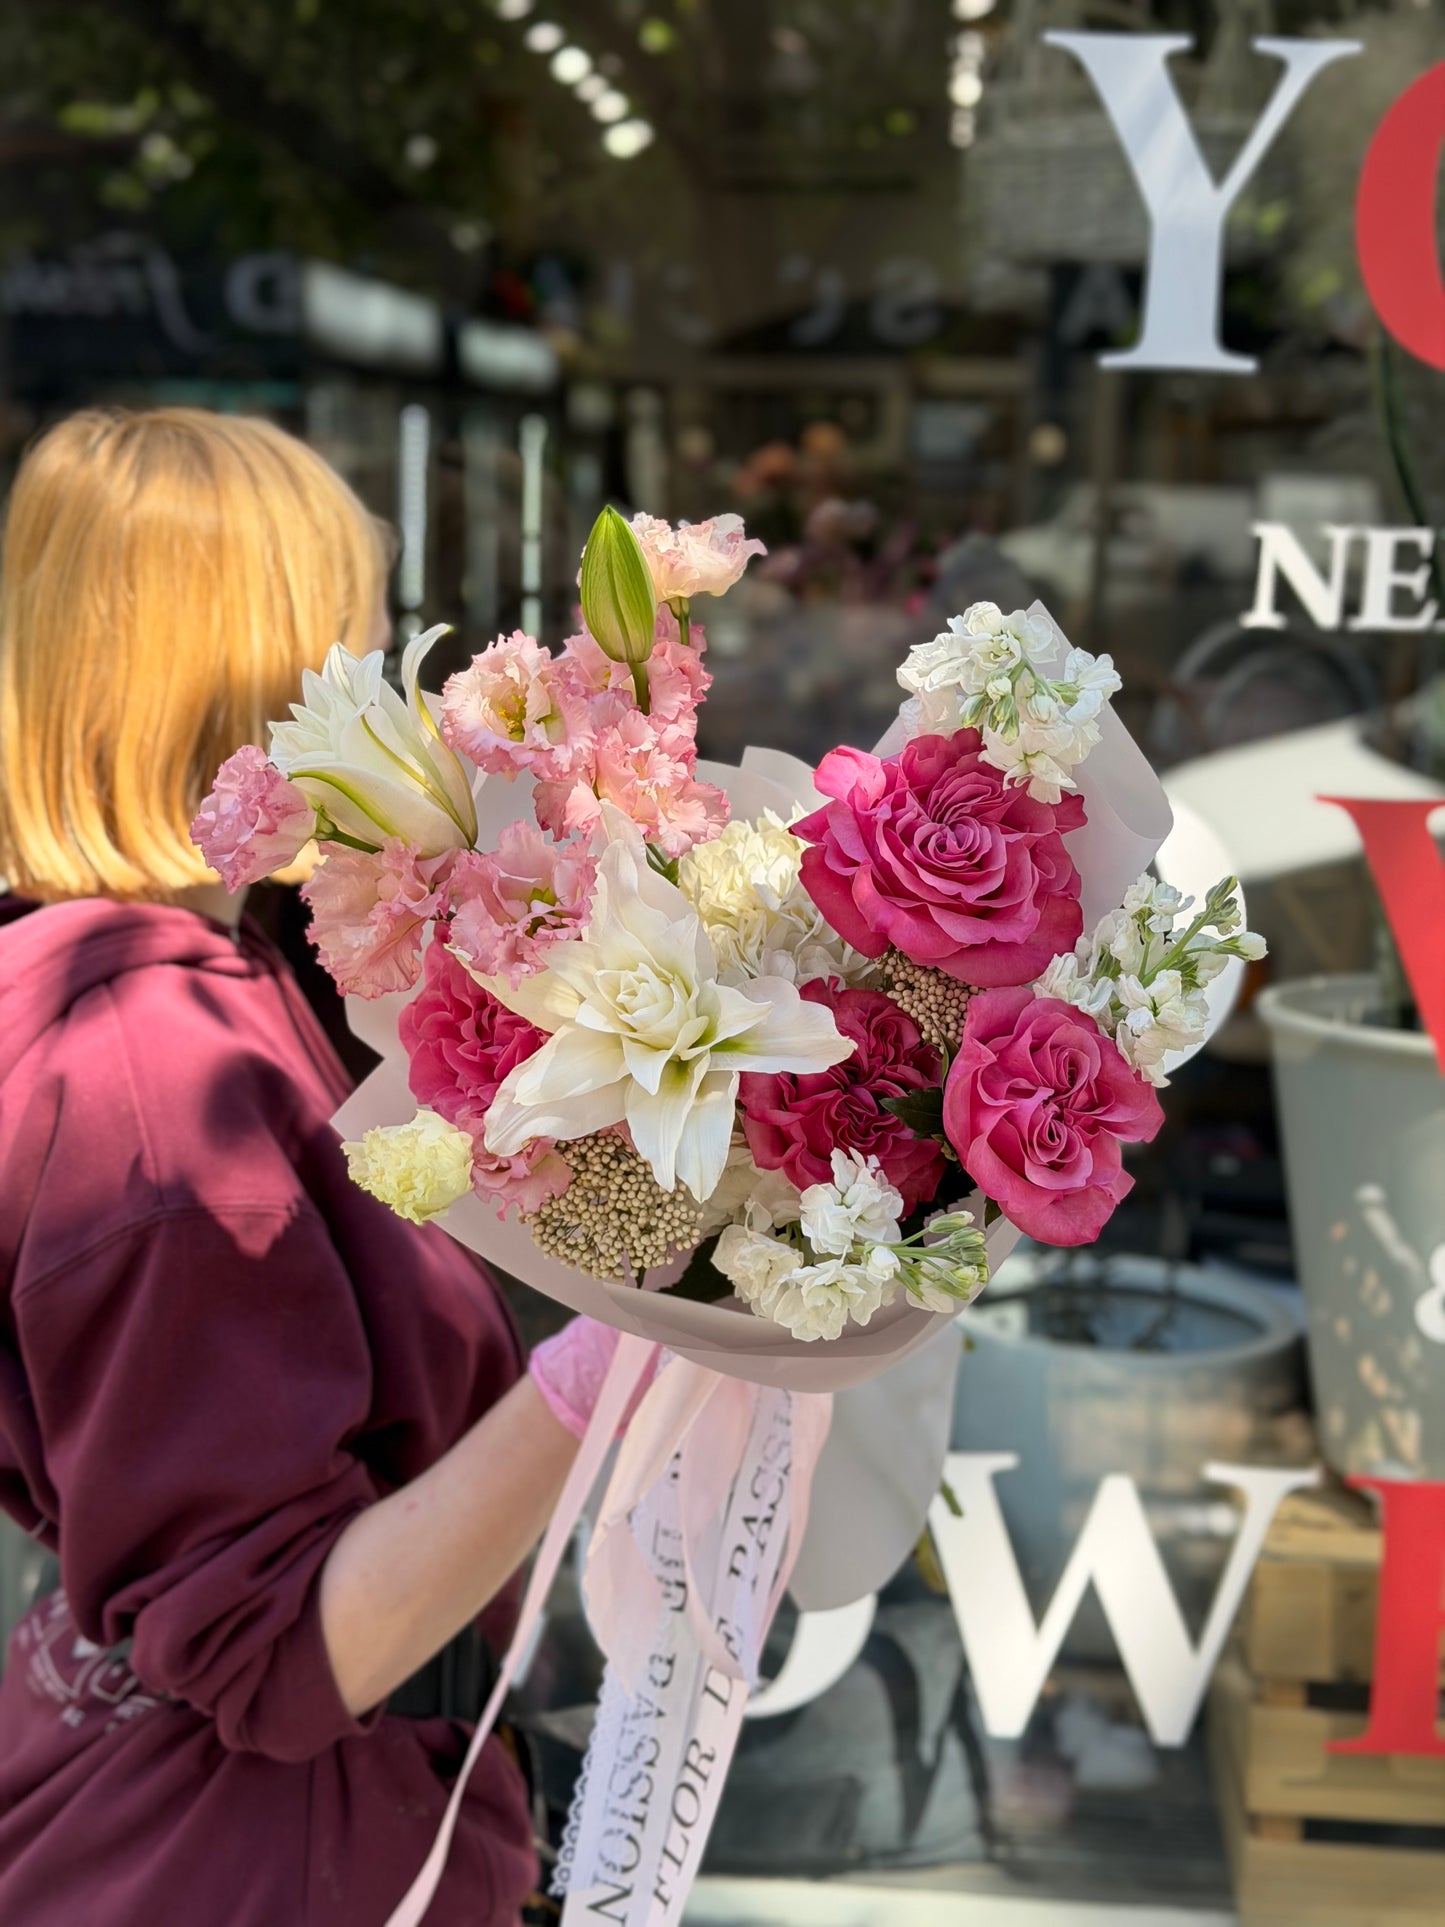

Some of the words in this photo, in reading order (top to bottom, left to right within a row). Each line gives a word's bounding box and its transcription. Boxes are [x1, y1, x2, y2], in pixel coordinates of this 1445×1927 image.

[1240, 522, 1445, 632] NE
[587, 1653, 676, 1926] PASSION
[652, 1738, 717, 1914] FLOR
